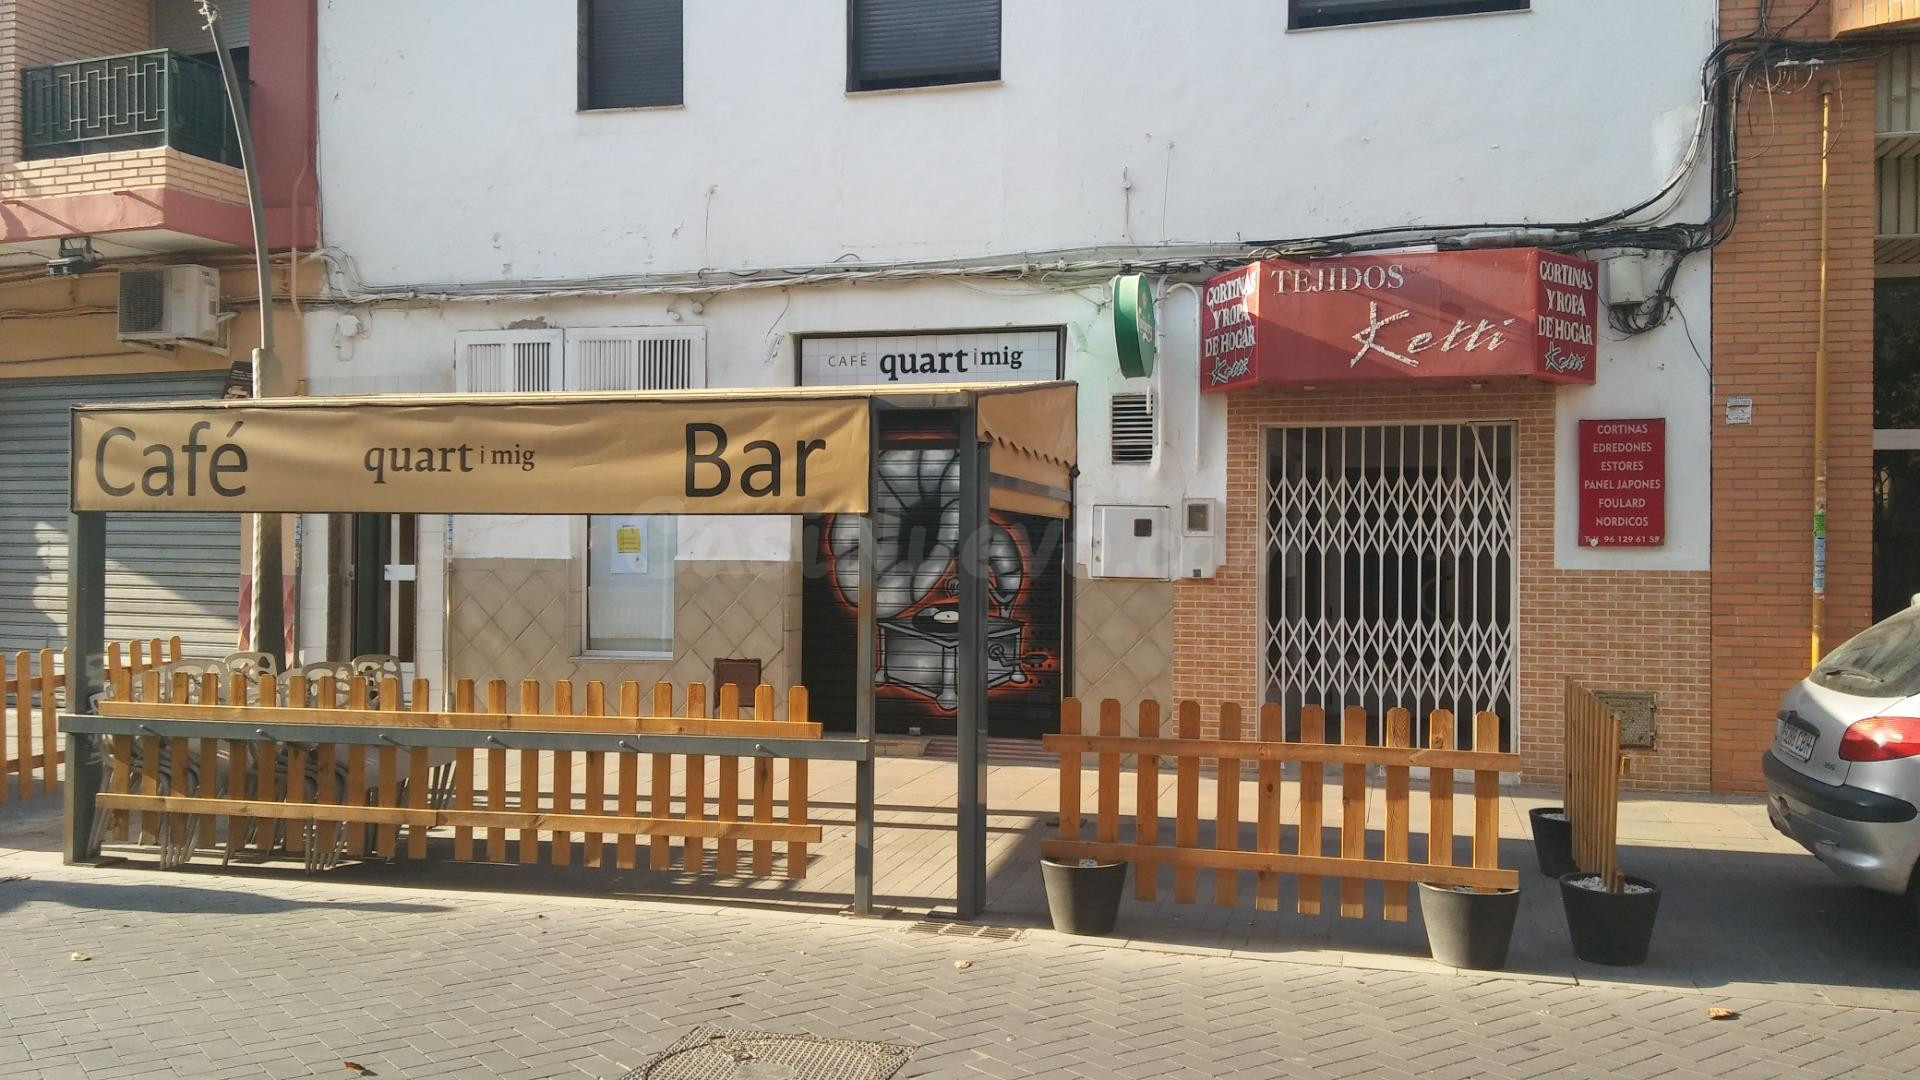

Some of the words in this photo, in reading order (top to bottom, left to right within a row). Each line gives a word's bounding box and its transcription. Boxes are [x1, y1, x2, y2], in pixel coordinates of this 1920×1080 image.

[1271, 264, 1404, 294] TEJIDOS
[1539, 260, 1593, 290] CORTINAS
[1206, 271, 1257, 308] CORTINAS
[828, 352, 868, 367] CAFÉ
[879, 349, 969, 381] quart
[980, 346, 1024, 370] mig
[1597, 424, 1648, 434] CORTINAS
[1593, 442, 1652, 453] EDREDONES
[95, 421, 248, 497] Café
[363, 443, 474, 484] quart
[490, 443, 536, 472] mig
[685, 422, 827, 498] Bar
[1601, 461, 1644, 471] ESTORES
[1584, 480, 1615, 490] PANEL
[1616, 479, 1661, 490] JAPONES
[1598, 498, 1646, 508] FOULARD
[1595, 516, 1649, 527] NORDICOS
[1603, 535, 1615, 544] 96
[1618, 535, 1633, 544] 129
[1635, 535, 1646, 544] 61
